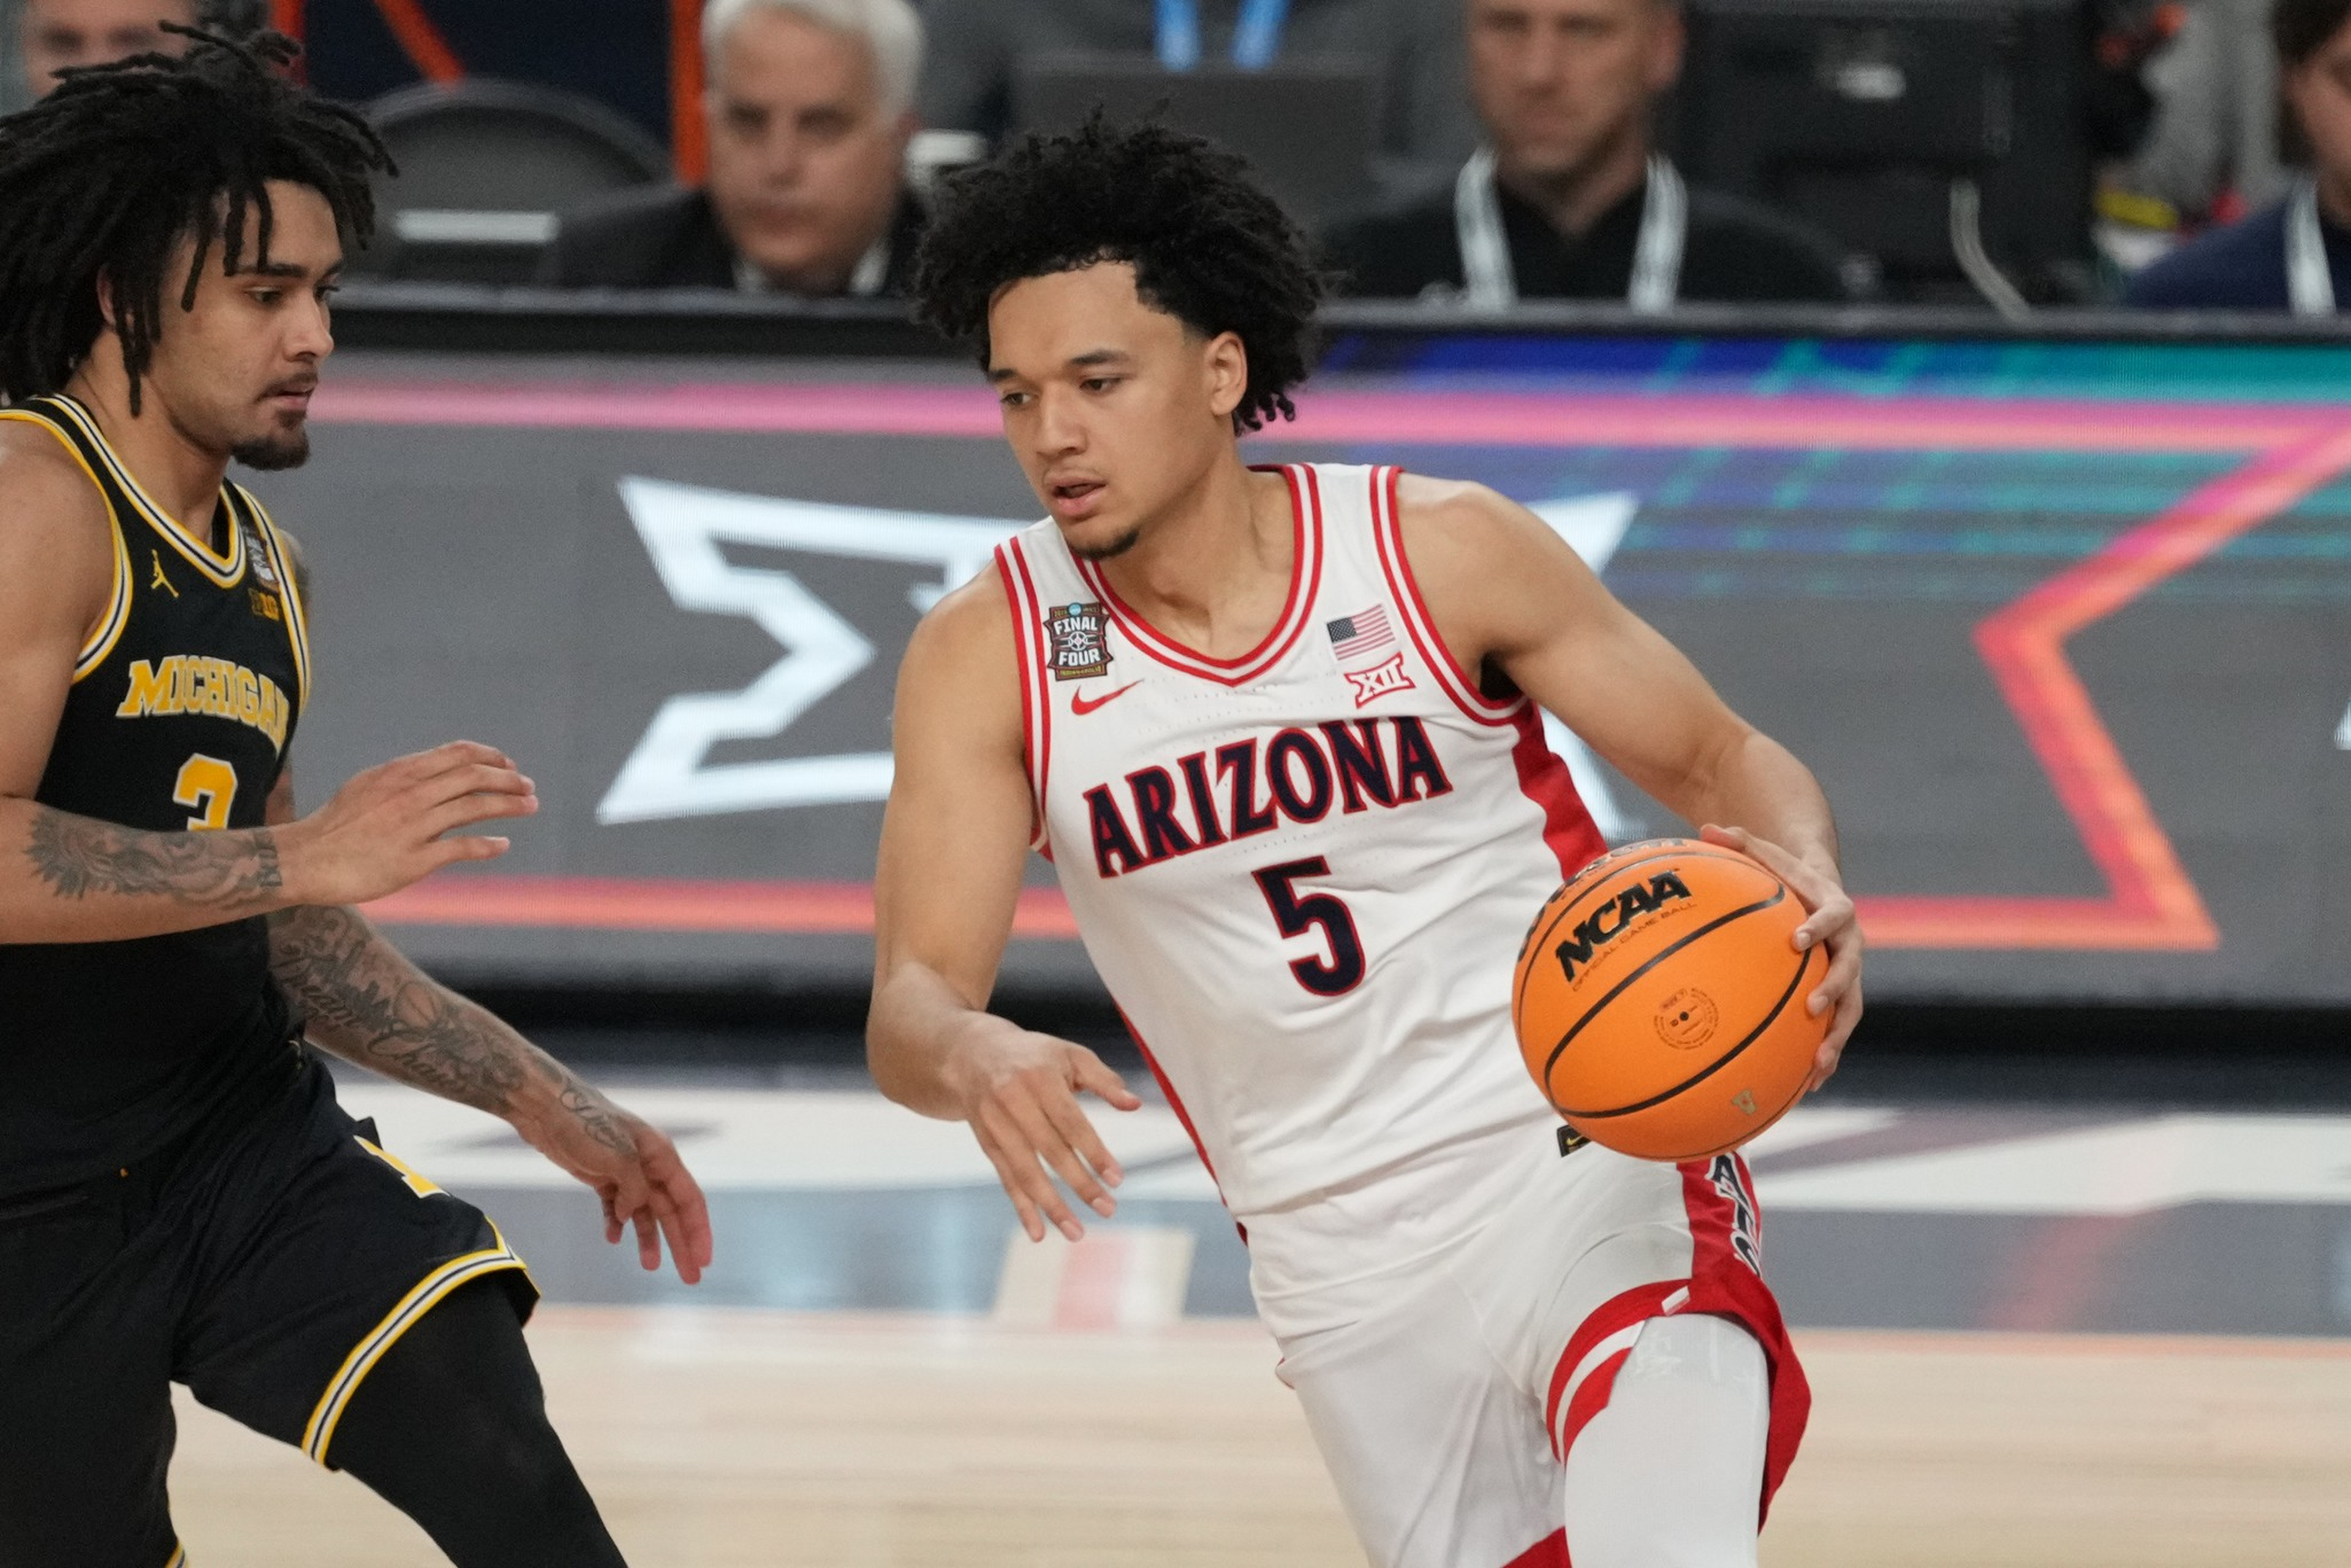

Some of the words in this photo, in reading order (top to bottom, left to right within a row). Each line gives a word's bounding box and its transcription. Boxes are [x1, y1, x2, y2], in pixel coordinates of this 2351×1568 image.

[1054, 616, 1098, 635] FINAL
[1059, 647, 1101, 667] FOUR
[115, 654, 290, 760] MICHIGAN
[1344, 651, 1416, 709] XII
[172, 752, 238, 831] 3
[1082, 716, 1453, 879] ARIZONA
[1251, 855, 1366, 997] 5
[1555, 870, 1692, 982] NCAA
[1619, 918, 1659, 944] GAME
[1660, 902, 1697, 919] BALL
